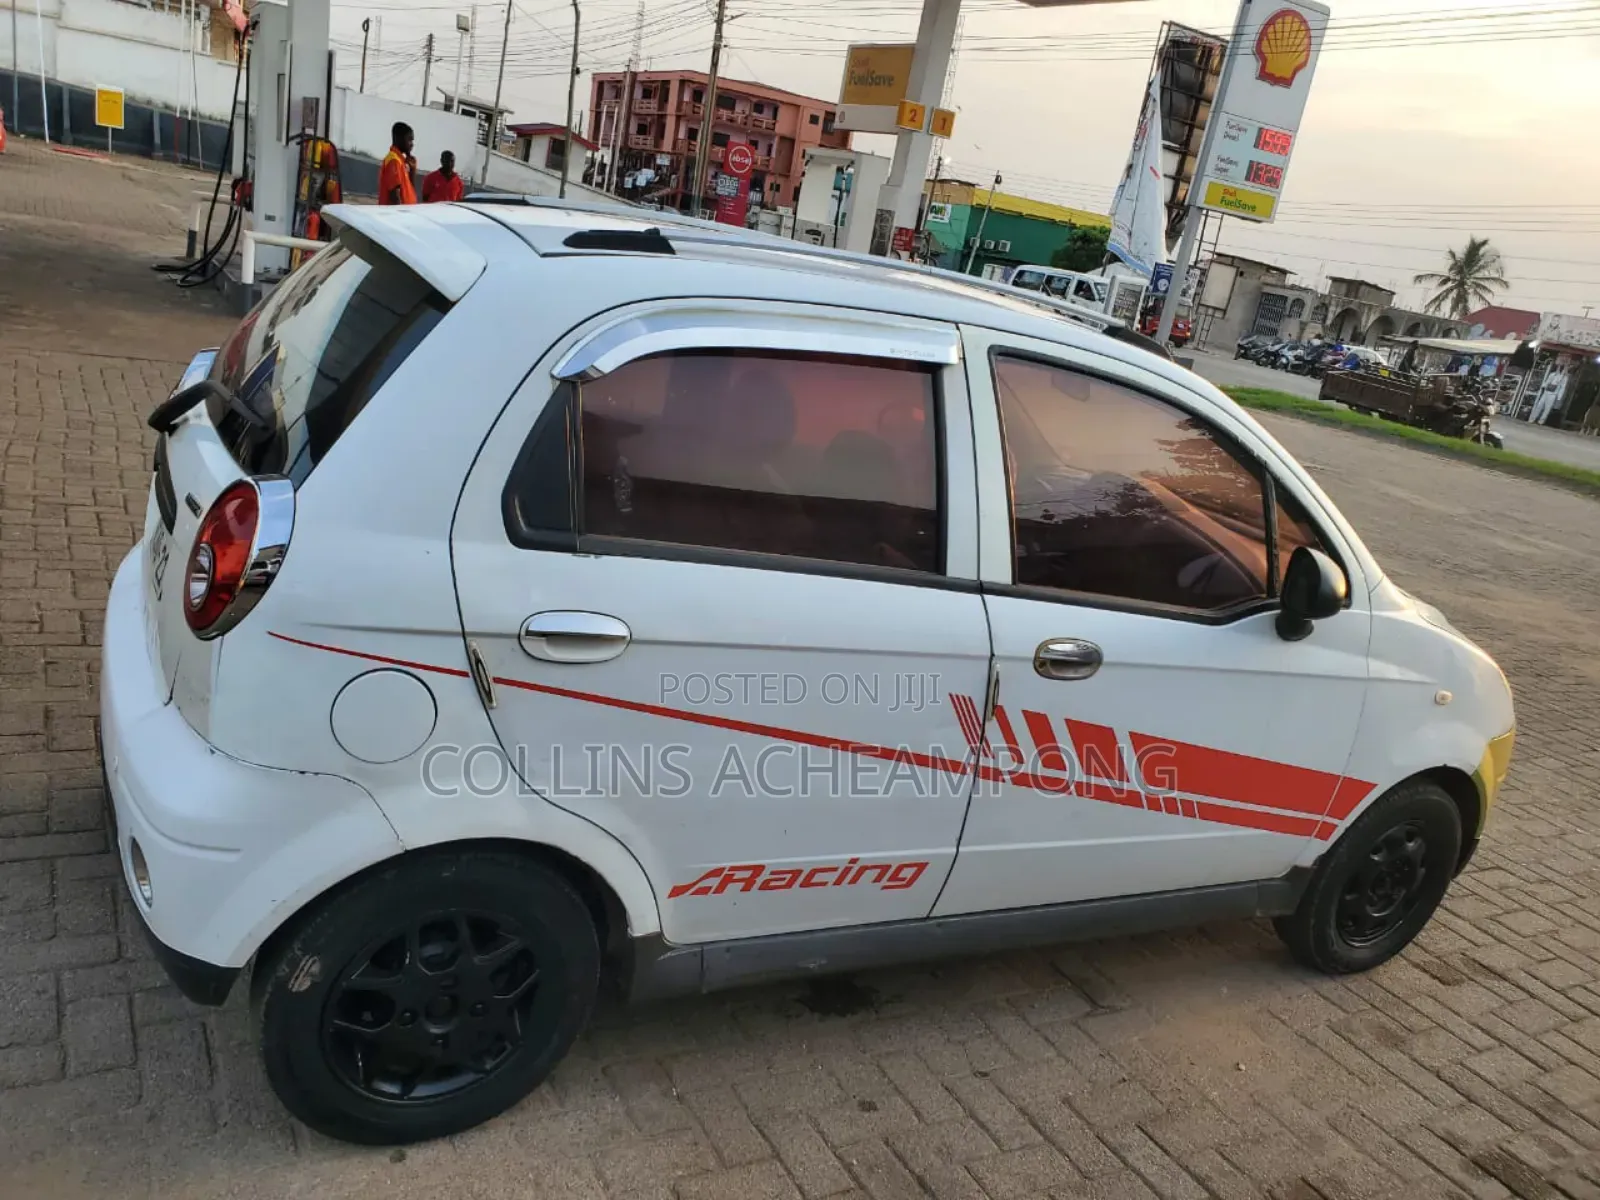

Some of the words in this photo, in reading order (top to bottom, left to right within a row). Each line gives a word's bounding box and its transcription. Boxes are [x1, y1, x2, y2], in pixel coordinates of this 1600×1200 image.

[848, 70, 895, 87] FuelSave
[908, 109, 917, 122] 2
[940, 117, 947, 131] 1
[1220, 196, 1256, 213] FuelSave
